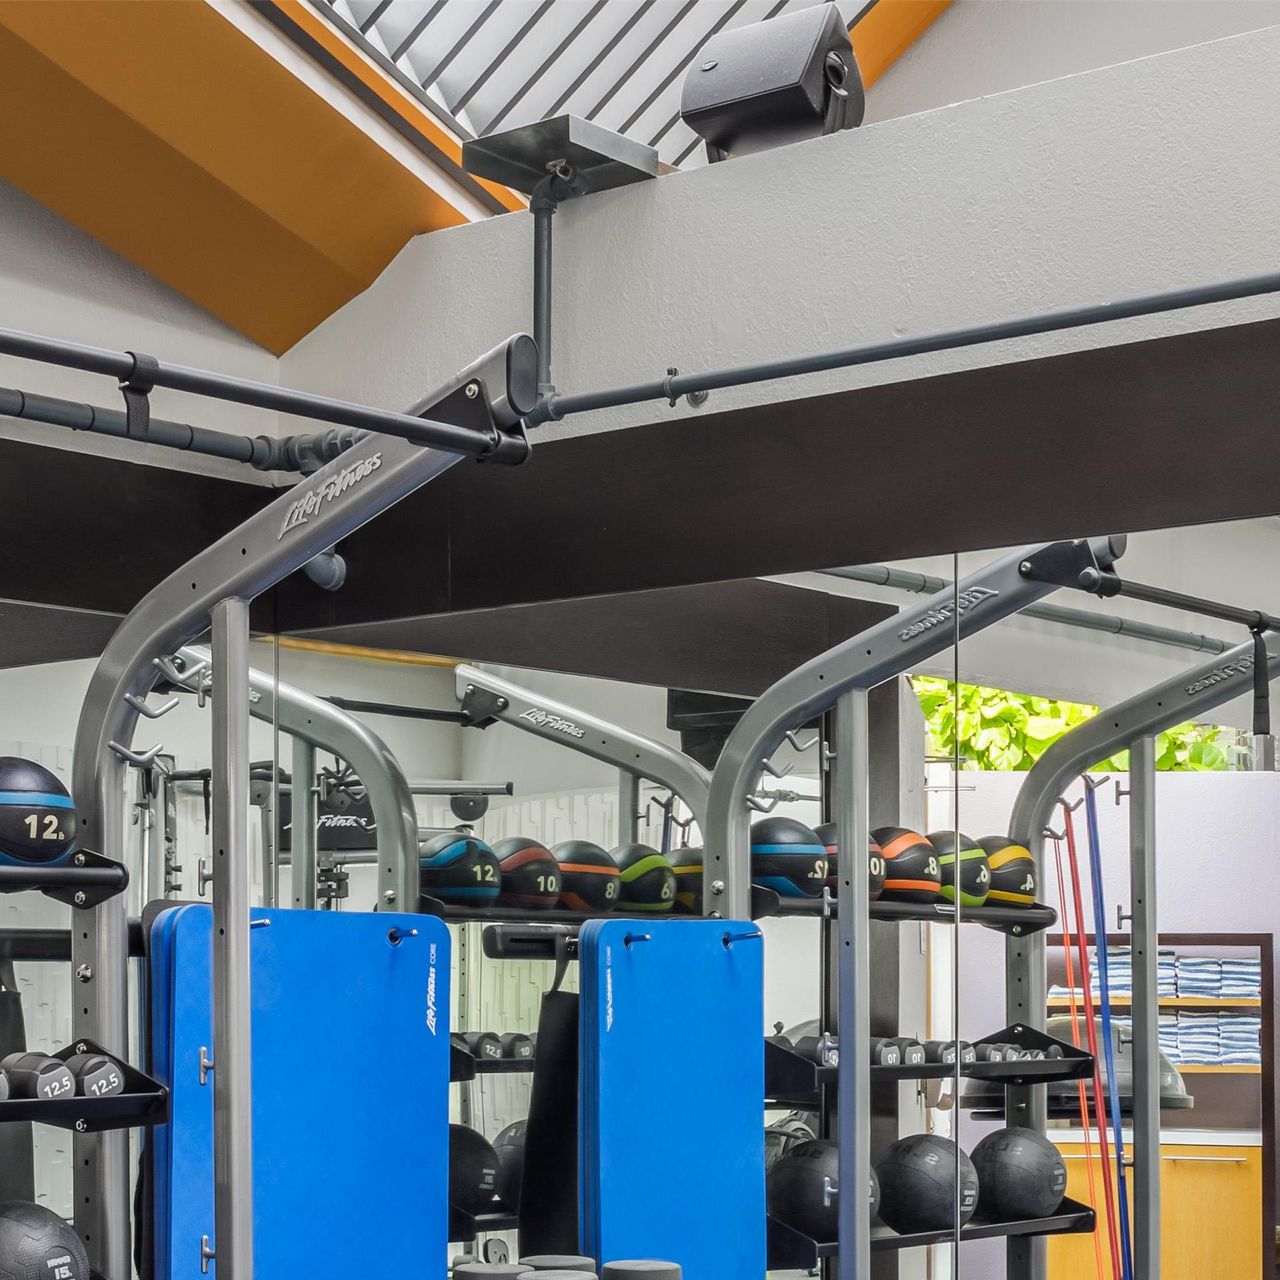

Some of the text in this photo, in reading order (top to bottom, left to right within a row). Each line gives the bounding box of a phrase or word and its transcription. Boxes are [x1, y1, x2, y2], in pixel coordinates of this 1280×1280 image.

[429, 943, 437, 964] CORE
[44, 1076, 71, 1098] 12.5
[91, 1073, 119, 1096] 12.5
